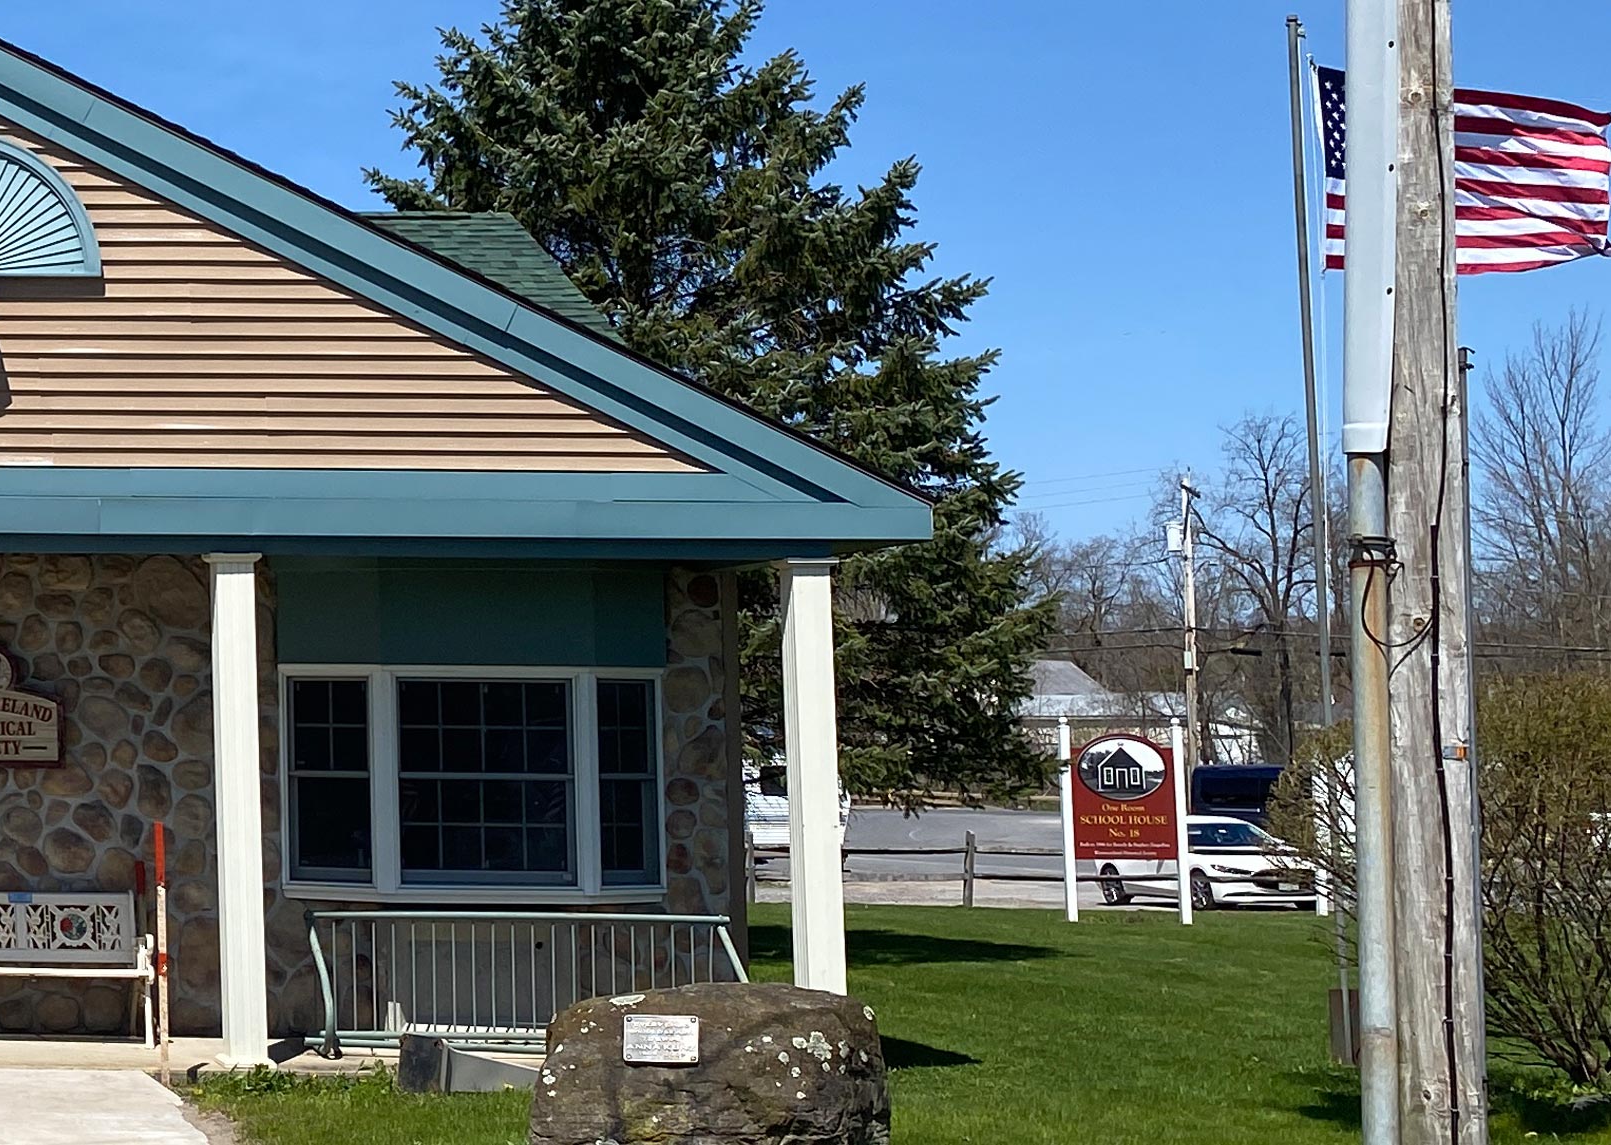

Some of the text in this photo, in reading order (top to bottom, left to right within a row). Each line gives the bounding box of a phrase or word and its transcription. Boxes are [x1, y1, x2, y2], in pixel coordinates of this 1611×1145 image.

[1101, 803, 1145, 812] One Room
[1079, 815, 1168, 825] SCHOOL HOUSE
[1108, 828, 1140, 838] No. 18
